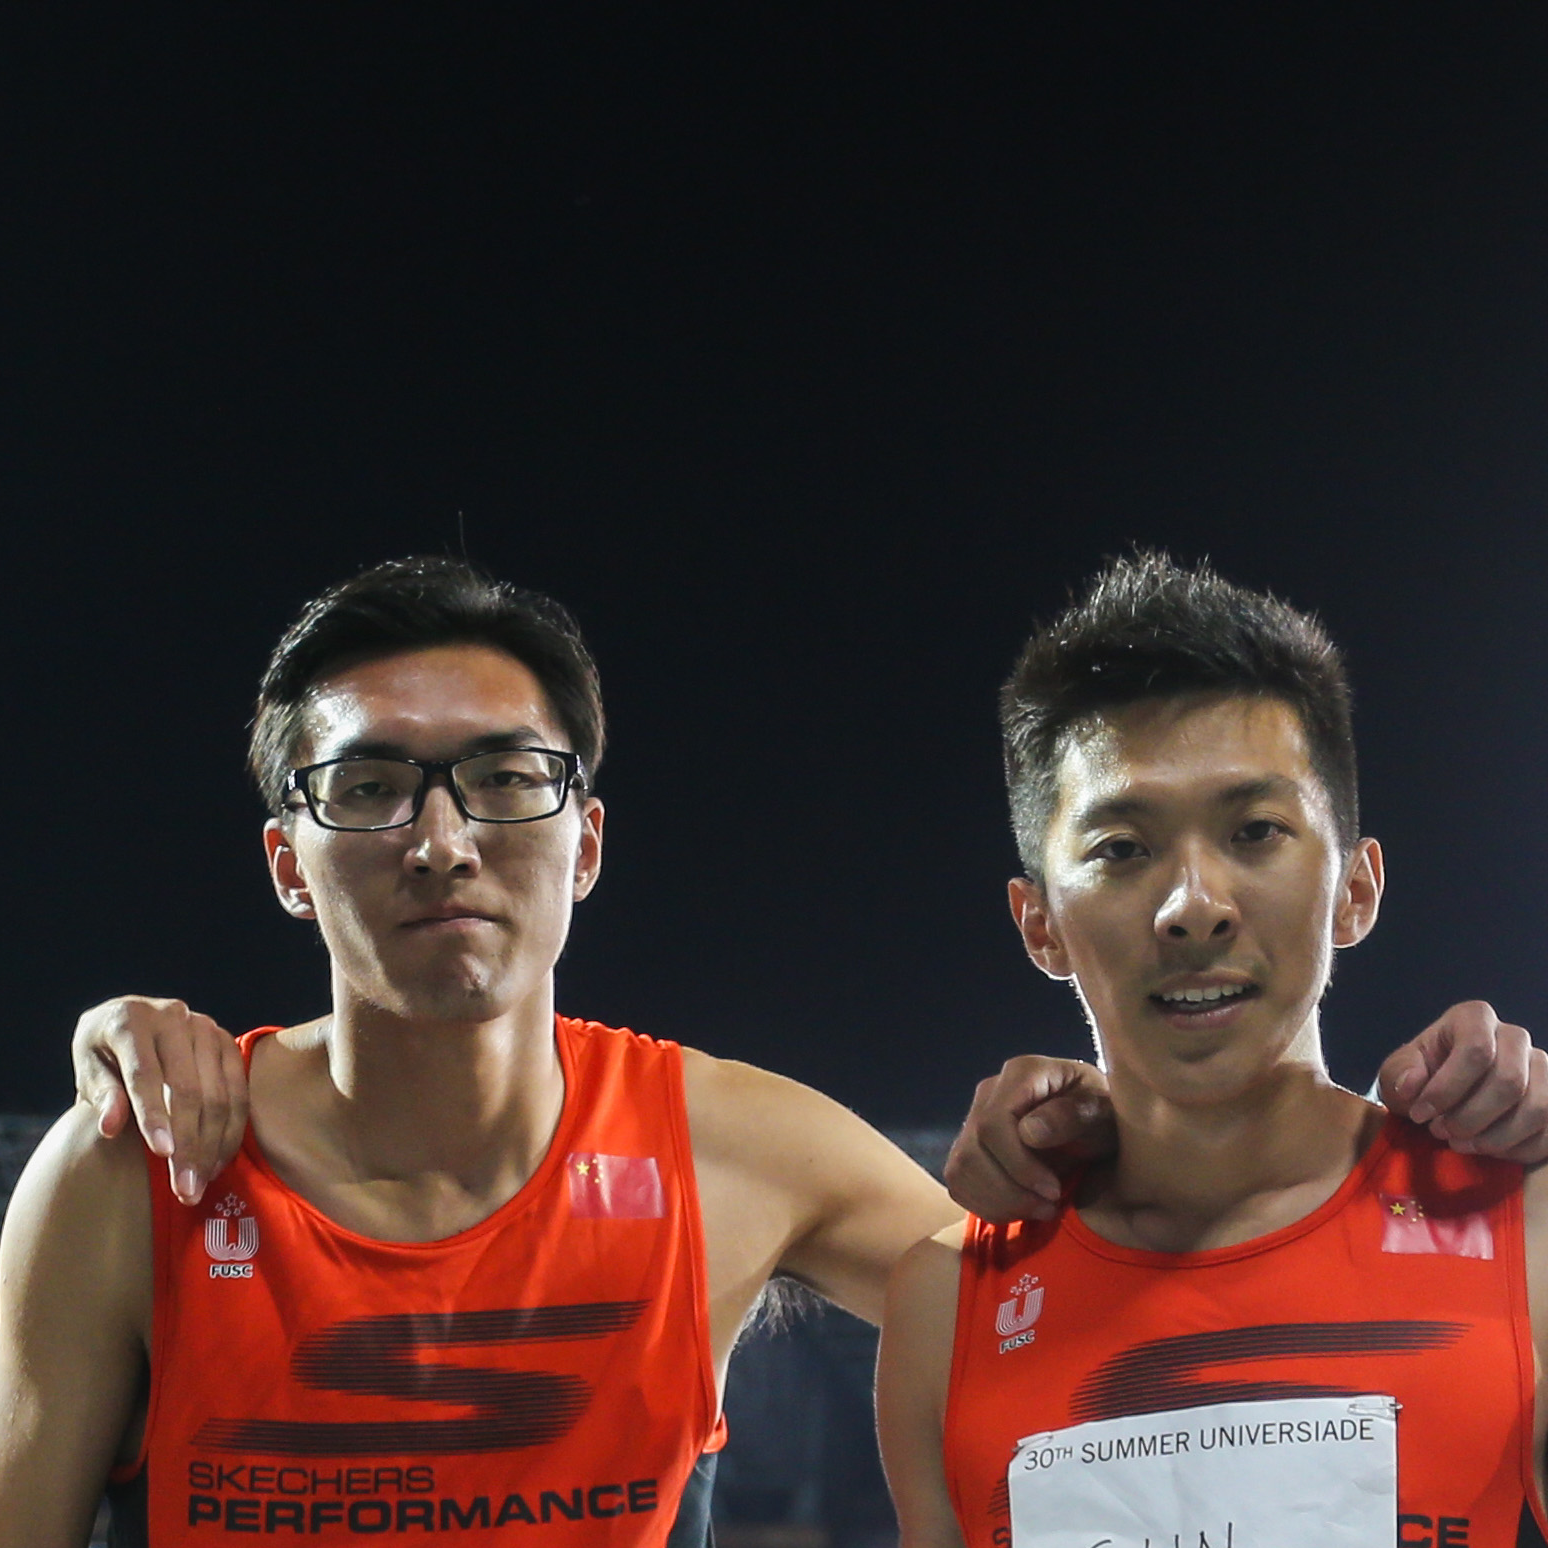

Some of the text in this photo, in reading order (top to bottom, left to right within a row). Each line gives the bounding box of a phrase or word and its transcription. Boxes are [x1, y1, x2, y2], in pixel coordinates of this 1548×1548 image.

[209, 1263, 253, 1279] FUSC
[999, 1330, 1035, 1354] FUSC
[1024, 1419, 1374, 1471] 30TH SUMMER UNIVERSIADE
[188, 1461, 435, 1495] SKECHERS
[188, 1479, 658, 1534] PERFORMANCE
